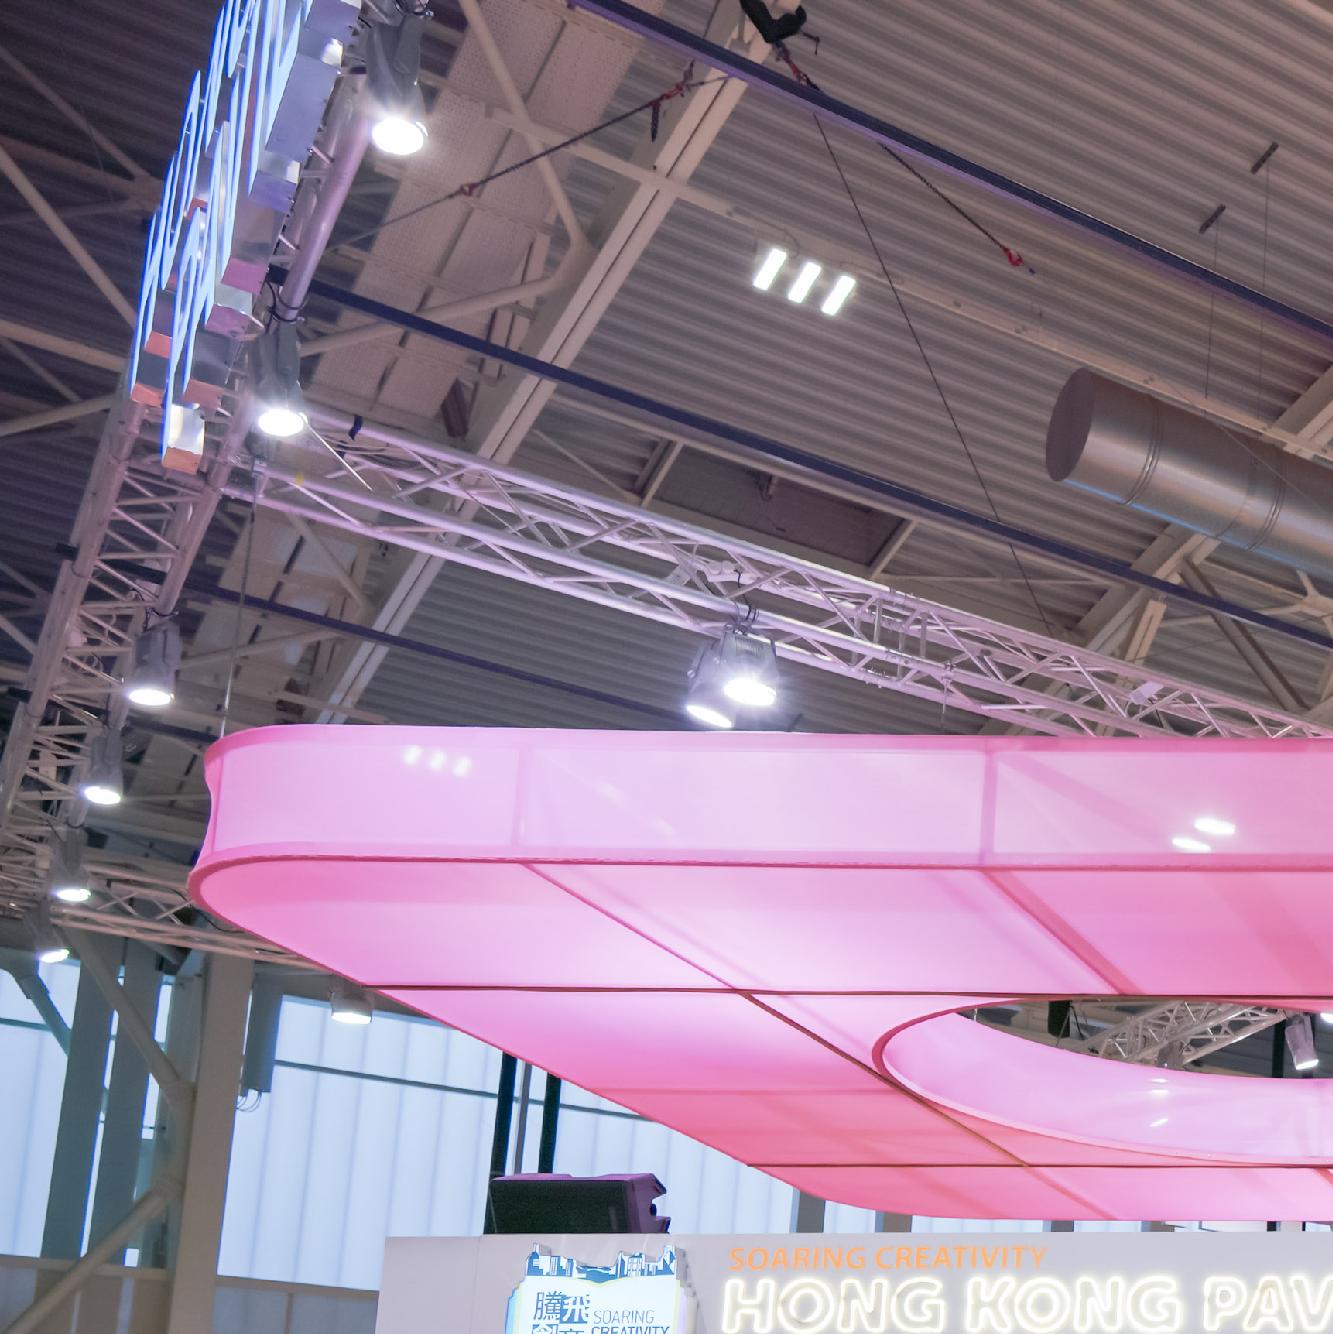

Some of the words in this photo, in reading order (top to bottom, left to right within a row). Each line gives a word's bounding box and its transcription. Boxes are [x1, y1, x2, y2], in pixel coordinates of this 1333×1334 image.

[728, 1247, 871, 1271] SOARING
[876, 1245, 1049, 1270] CREATIVITY
[591, 1309, 655, 1325] SOARING
